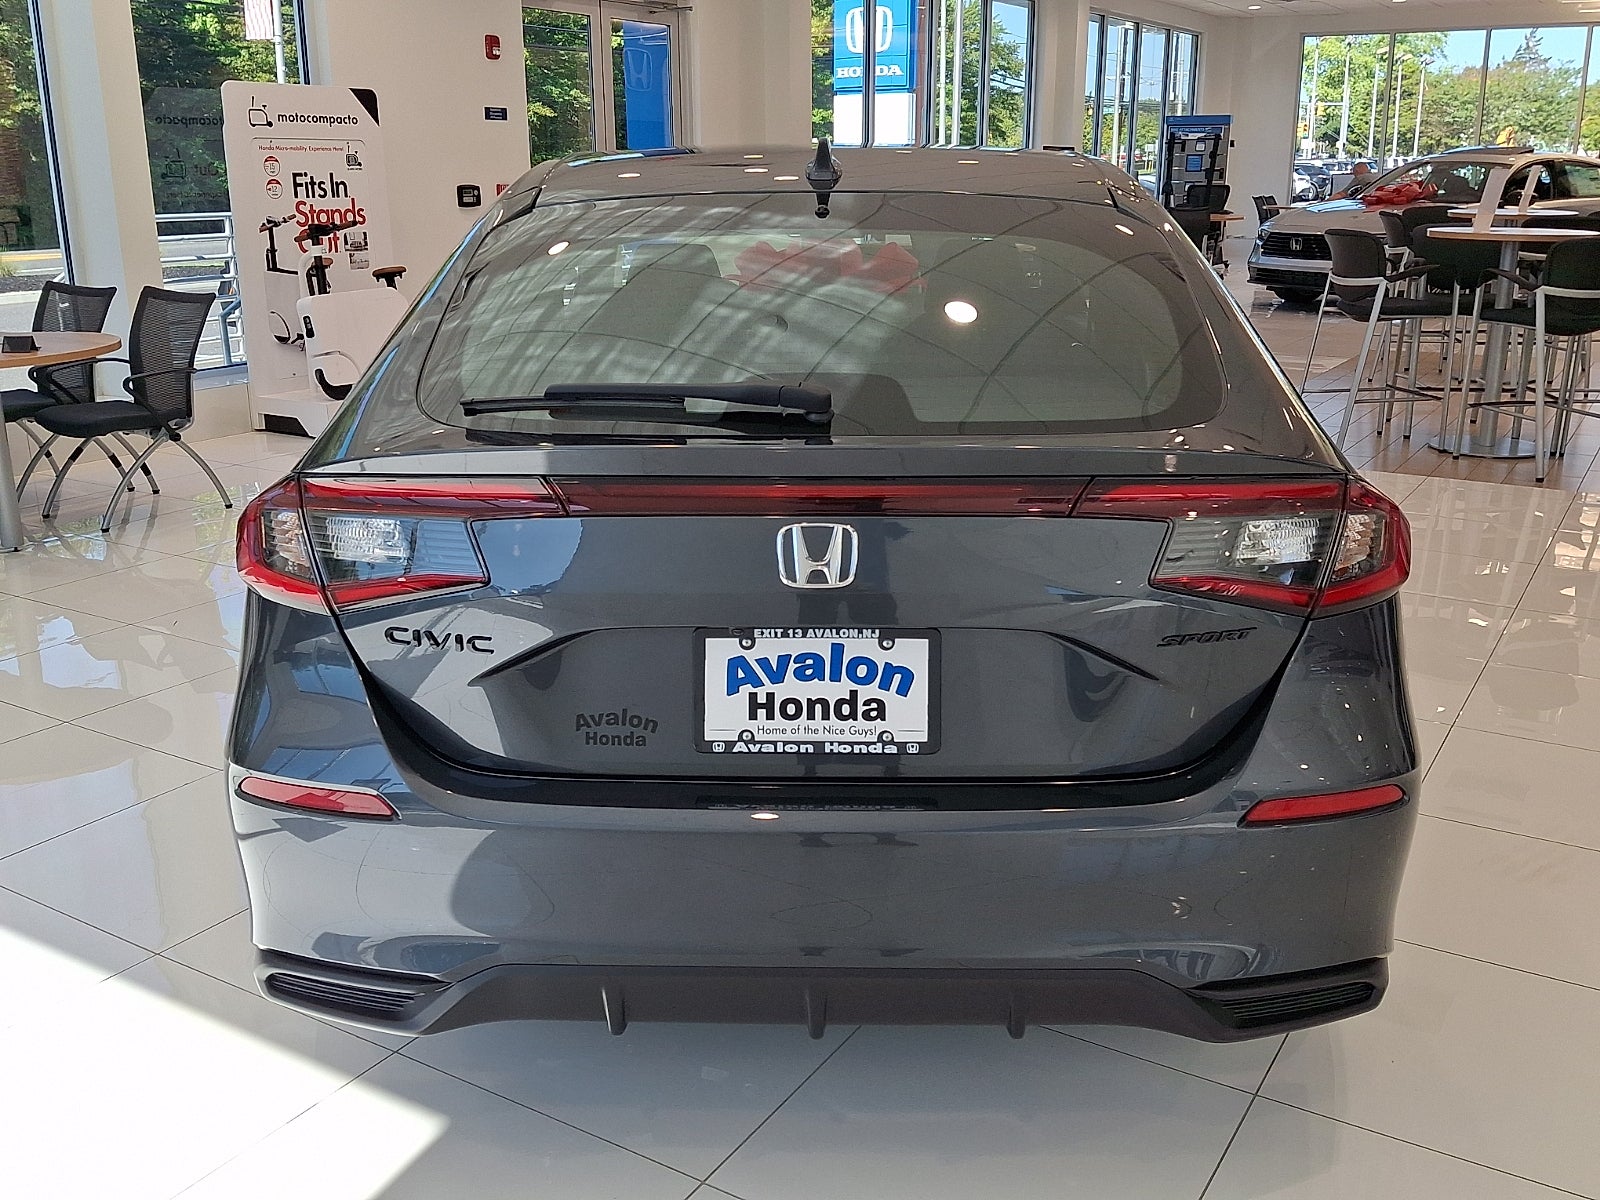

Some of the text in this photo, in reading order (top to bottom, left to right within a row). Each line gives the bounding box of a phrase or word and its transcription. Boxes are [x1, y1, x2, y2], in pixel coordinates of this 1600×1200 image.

[835, 64, 904, 79] HODA
[277, 111, 359, 127] motocompacto
[292, 172, 327, 199] Fits
[295, 197, 367, 228] Stands
[384, 626, 495, 655] CIVIC
[753, 628, 784, 639] EXIT
[787, 628, 803, 639] 13
[1156, 626, 1258, 648] SPORT
[726, 642, 915, 697] Avalon
[748, 689, 887, 722] Honda
[575, 708, 659, 734] Avalon
[757, 725, 877, 738] Home of the Nice Guys!
[585, 731, 647, 747] Honda
[732, 741, 898, 754] Avalon Honda
